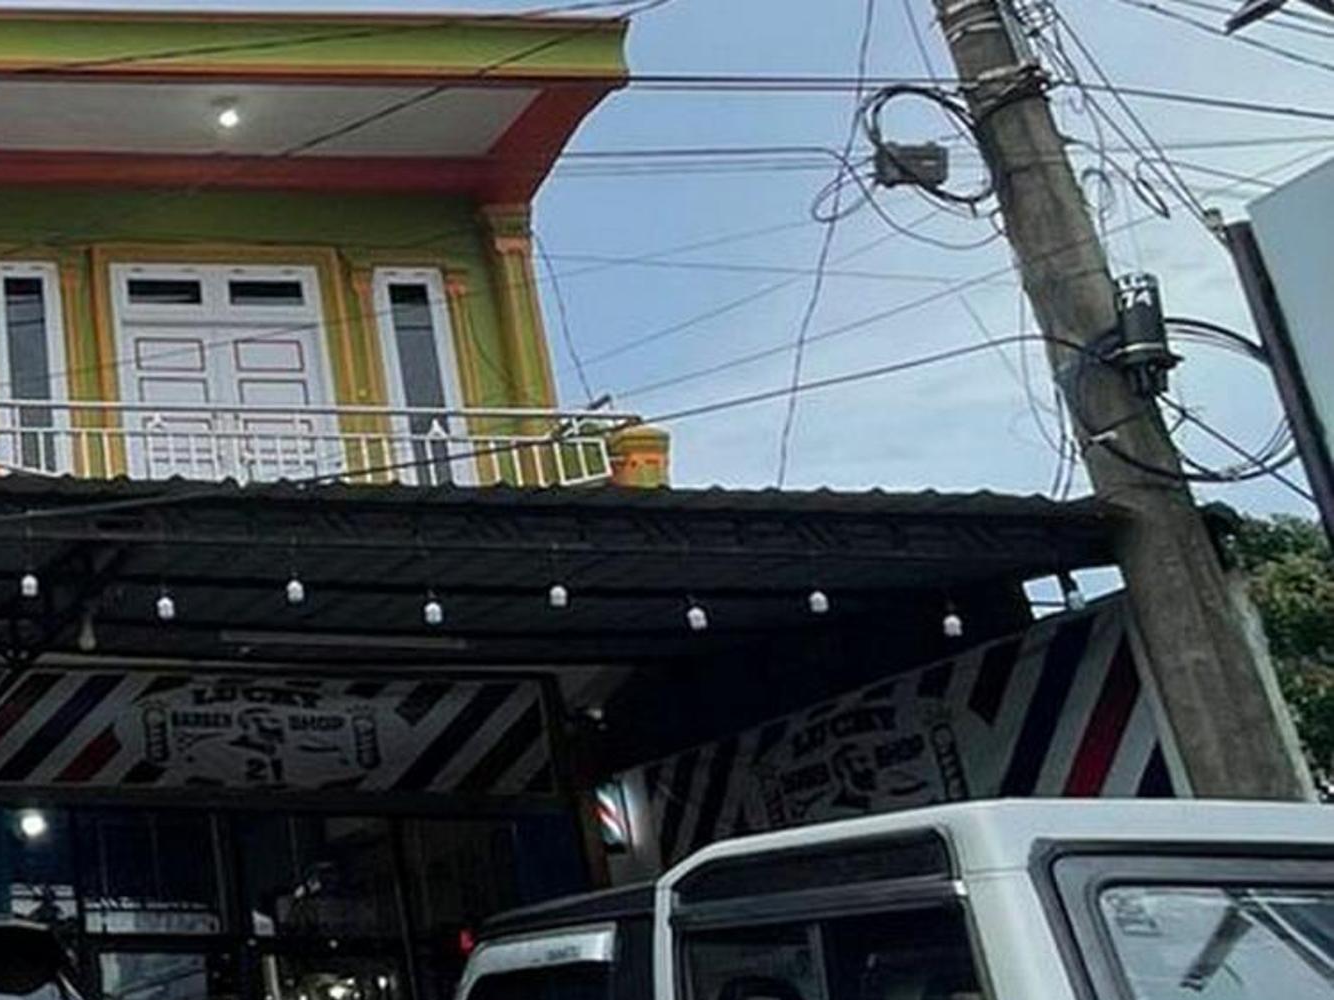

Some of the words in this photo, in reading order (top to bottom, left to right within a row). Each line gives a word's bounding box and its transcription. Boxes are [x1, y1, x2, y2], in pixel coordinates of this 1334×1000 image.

[193, 688, 319, 708] LUCKY
[288, 715, 345, 731] SHOP
[794, 706, 895, 757] LUCKY
[245, 759, 283, 781] 21
